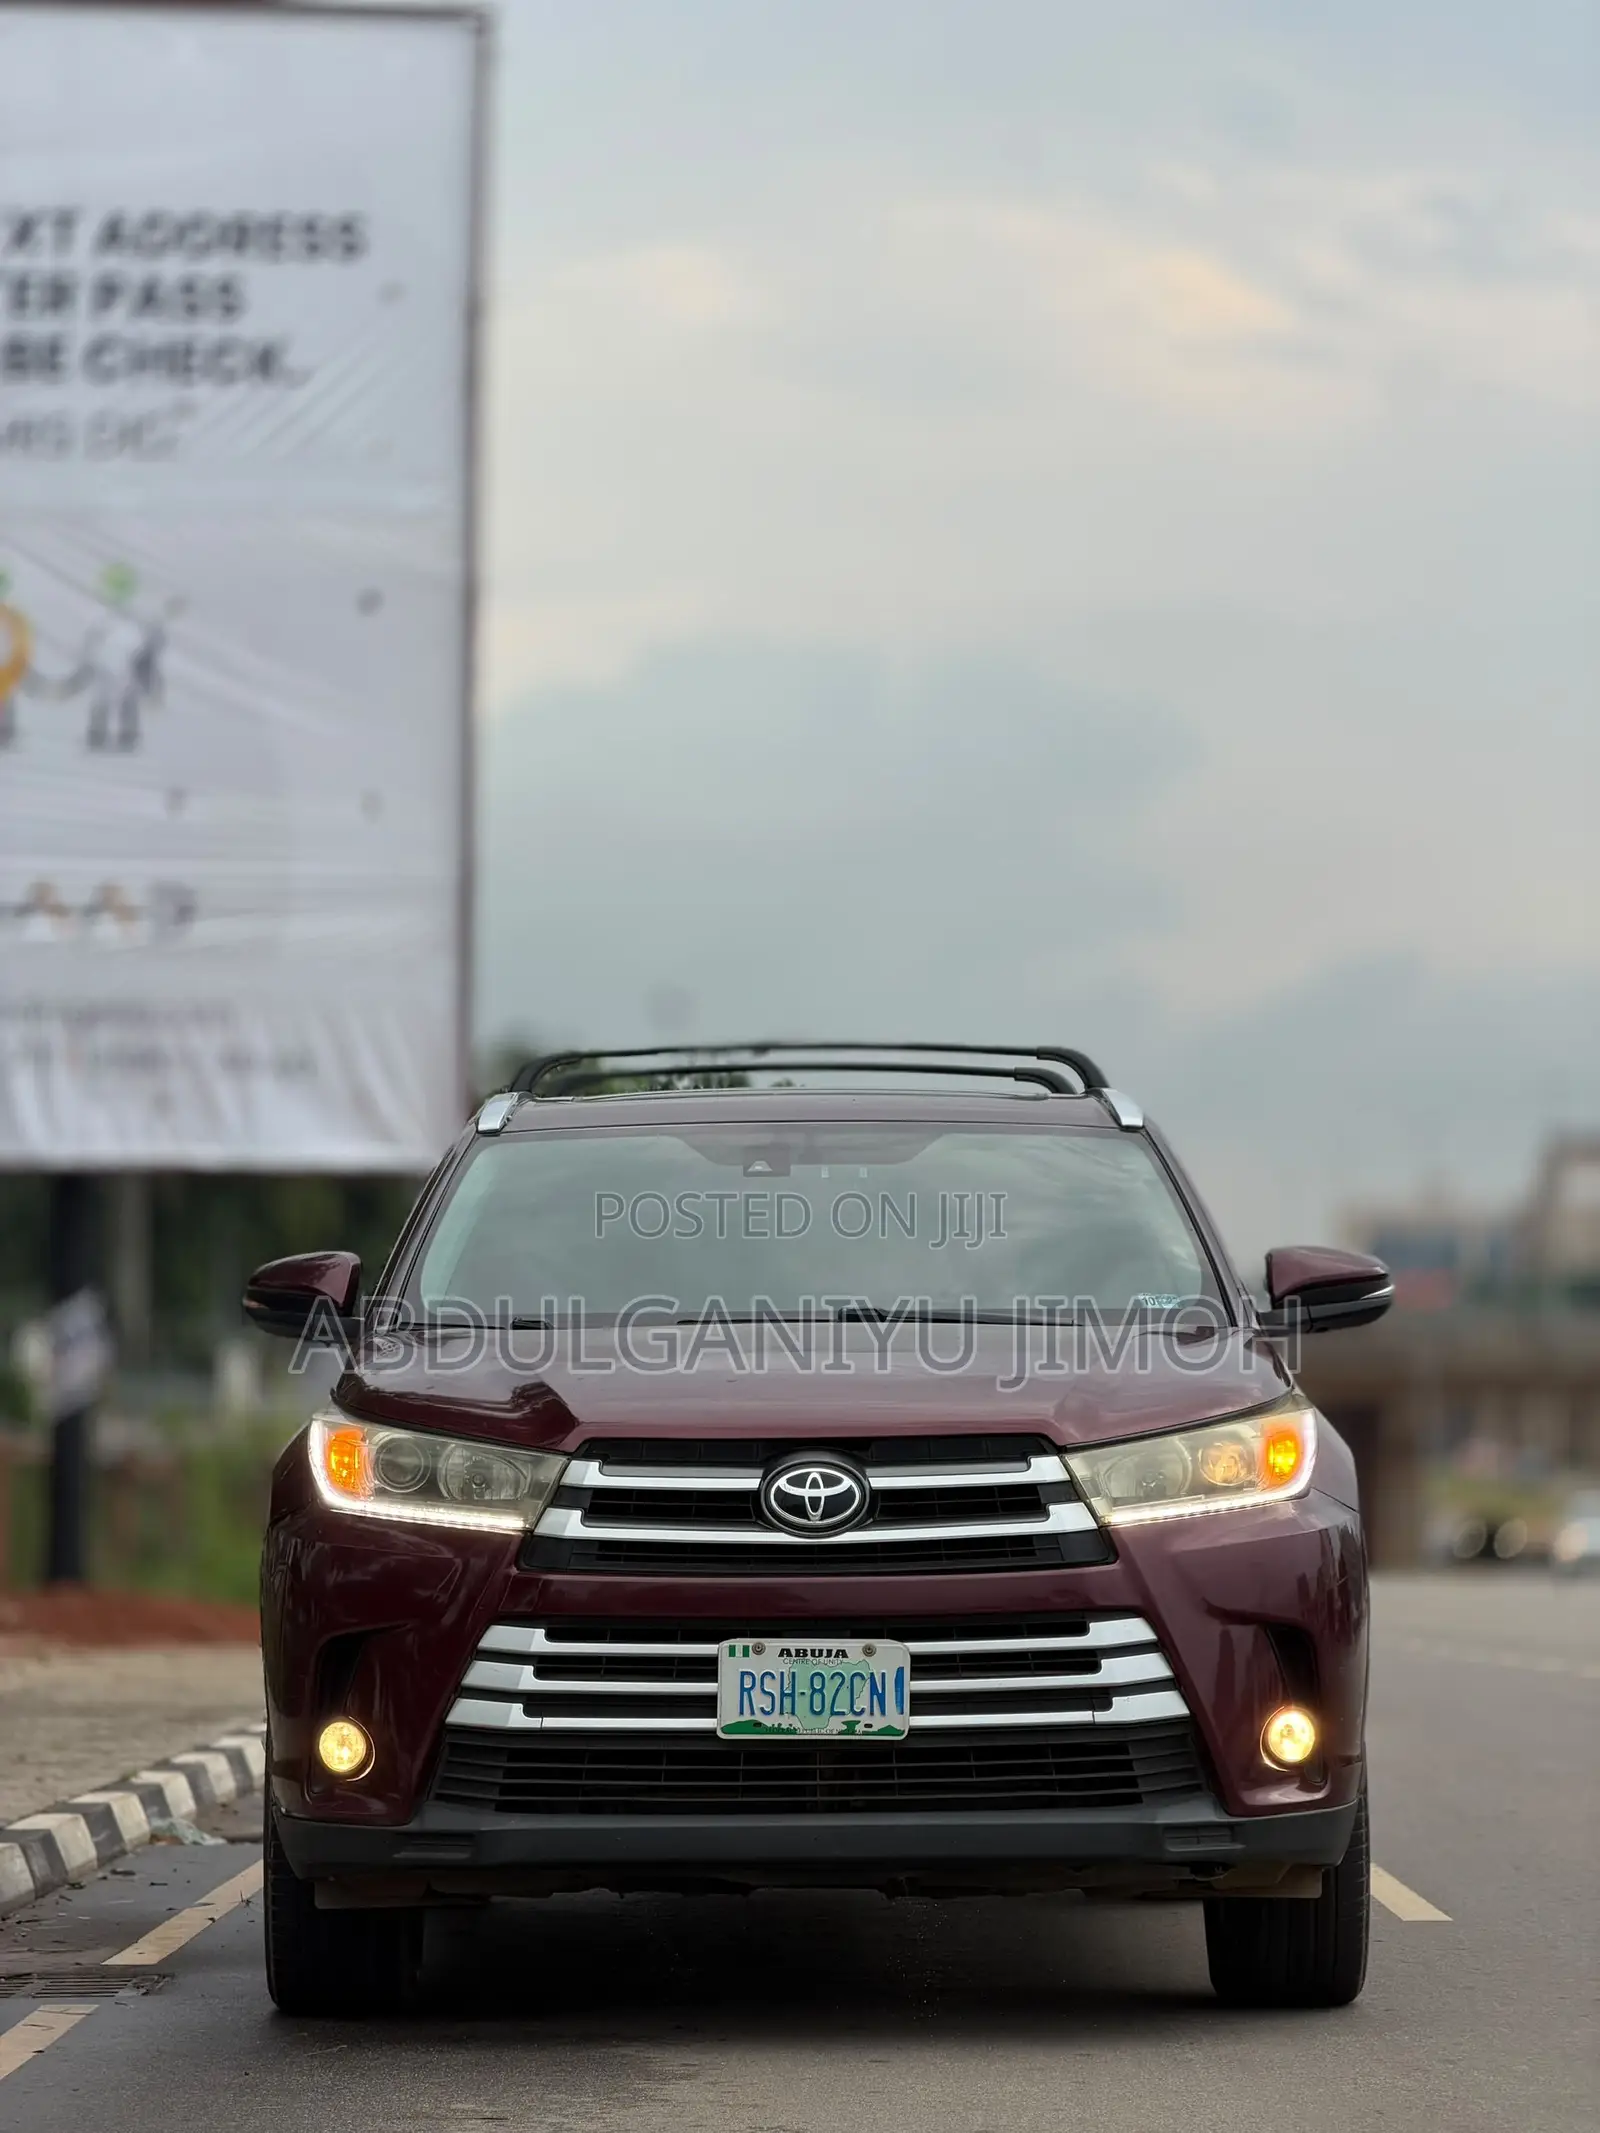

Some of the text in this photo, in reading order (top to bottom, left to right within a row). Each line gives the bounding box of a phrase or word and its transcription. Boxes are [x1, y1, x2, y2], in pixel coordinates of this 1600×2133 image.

[93, 208, 368, 264] ADDRESS
[0, 270, 247, 324] ER PASS
[778, 1648, 849, 1659] ABUJA
[823, 1658, 844, 1666] UNITY
[739, 1669, 887, 1717] RSH-82CN
